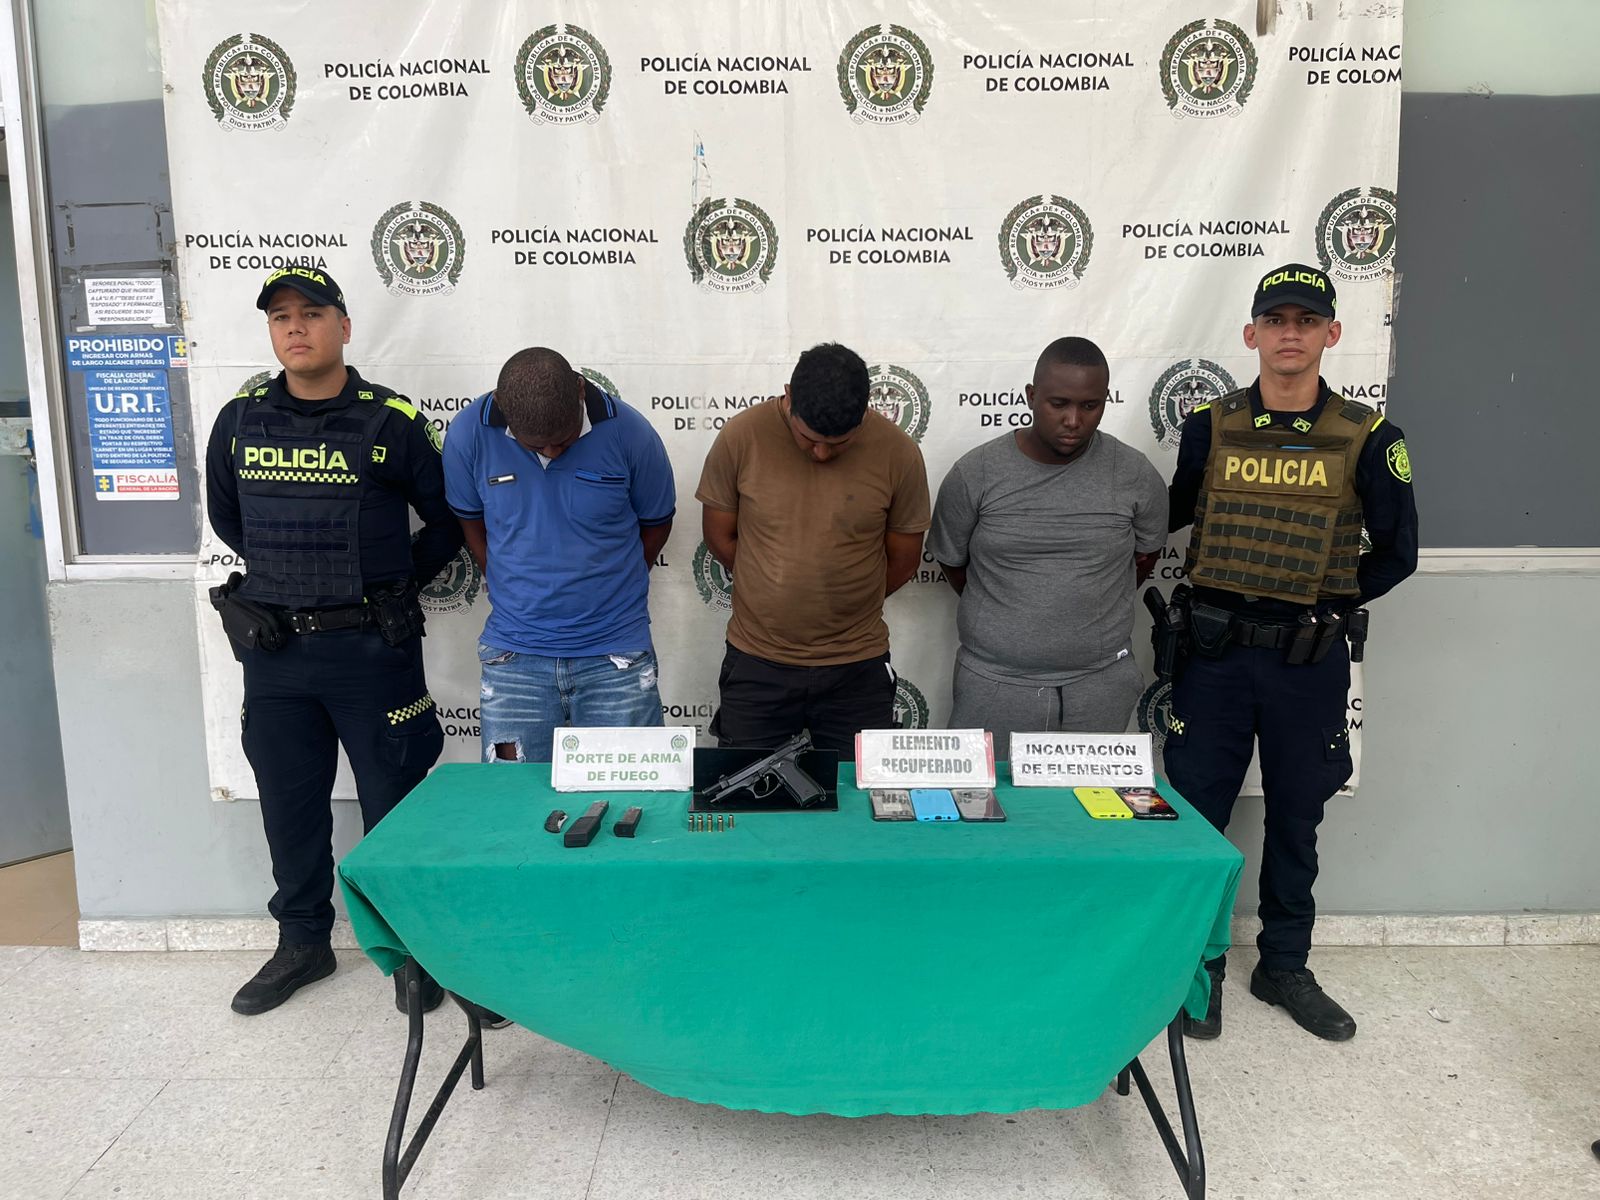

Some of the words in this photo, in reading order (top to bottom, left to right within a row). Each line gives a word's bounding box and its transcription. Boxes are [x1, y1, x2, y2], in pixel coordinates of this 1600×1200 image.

[576, 41, 599, 80] COLOMBIA
[900, 40, 921, 80] COLOMBIA
[964, 50, 1033, 69] POLICÍA
[1040, 53, 1134, 68] NACIONAL
[1224, 35, 1245, 73] COLOMBIA
[1289, 43, 1356, 62] POLICÍA
[261, 49, 285, 87] COLOMBIA
[325, 59, 393, 78] POLICÍA
[400, 59, 490, 76] NACIONAL
[641, 53, 711, 72] POLICÍA
[717, 57, 811, 72] NACIONAL
[986, 77, 1008, 92] DE
[1015, 76, 1109, 91] COLOMBIA
[1307, 70, 1330, 85] DE
[1337, 67, 1401, 83] COLOM
[349, 86, 371, 100] DE
[378, 83, 468, 99] COLOMBIA
[664, 80, 687, 95] DE
[693, 80, 788, 95] COLOMBIA
[1175, 84, 1198, 105] POLICIA
[1207, 80, 1241, 106] NACIONAL
[220, 97, 244, 118] POLICIA
[253, 96, 283, 119] NACIONAL
[532, 90, 557, 112] POLICIA
[565, 87, 596, 113] NACIONAL
[854, 90, 877, 111] POLICIA
[885, 88, 918, 112] NACIONAL
[565, 111, 589, 122] PATRIA
[886, 110, 910, 122] PATRIA
[1206, 104, 1231, 116] PATRIA
[254, 117, 276, 129] PATRIA
[431, 217, 454, 254] COLOMBIA
[492, 225, 561, 243] POLICÍA
[567, 229, 658, 243] NACIONAL
[745, 213, 766, 251] COLOMBIA
[807, 224, 876, 242] POLICÍA
[882, 227, 973, 242] NACIONAL
[1060, 210, 1081, 247] COLOMBIA
[1123, 219, 1193, 238] POLICÍA
[1200, 220, 1289, 236] NACIONAL
[185, 230, 254, 248] POLICÍA
[259, 234, 347, 248] NACIONAL
[515, 251, 537, 265] DE
[543, 251, 636, 265] COLOMBIA
[830, 251, 851, 264] DE
[858, 250, 950, 264] COLOMBIA
[1145, 244, 1167, 259] DE
[1174, 243, 1264, 258] COLOMBIA
[1329, 249, 1352, 270] POLICIA
[210, 256, 231, 269] DE
[237, 256, 327, 269] COLOMBIA
[732, 259, 764, 282] NACIONAL
[1014, 257, 1037, 277] POLICIA
[1046, 256, 1079, 278] NACIONAL
[389, 263, 413, 283] POLICIA
[422, 262, 452, 285] NACIONAL
[1045, 276, 1069, 287] PATRIA
[1263, 271, 1325, 292] POLICÍA
[423, 283, 445, 294] PATRIA
[732, 280, 756, 291] PATRIA
[69, 339, 164, 352] PROHIBIDO
[95, 393, 161, 413] U.R.I.
[959, 388, 1026, 406] POLICÍA
[674, 417, 696, 430] DE
[981, 414, 1002, 426] DE
[244, 443, 349, 471] POLICÍA
[117, 473, 177, 483] FISCALÍA
[1224, 456, 1328, 487] POLICIA
[892, 736, 960, 750] ELEMENTO
[1026, 743, 1136, 756] INCAUTACIÓN
[566, 753, 613, 763] PORTE
[618, 753, 636, 763] DE
[641, 753, 681, 763] ARMA
[882, 758, 972, 773] RECUPERADO
[588, 771, 606, 781] DE
[611, 771, 659, 781] FUEGO
[1022, 764, 1042, 774] DE
[1048, 764, 1143, 775] ELEMENTOS
